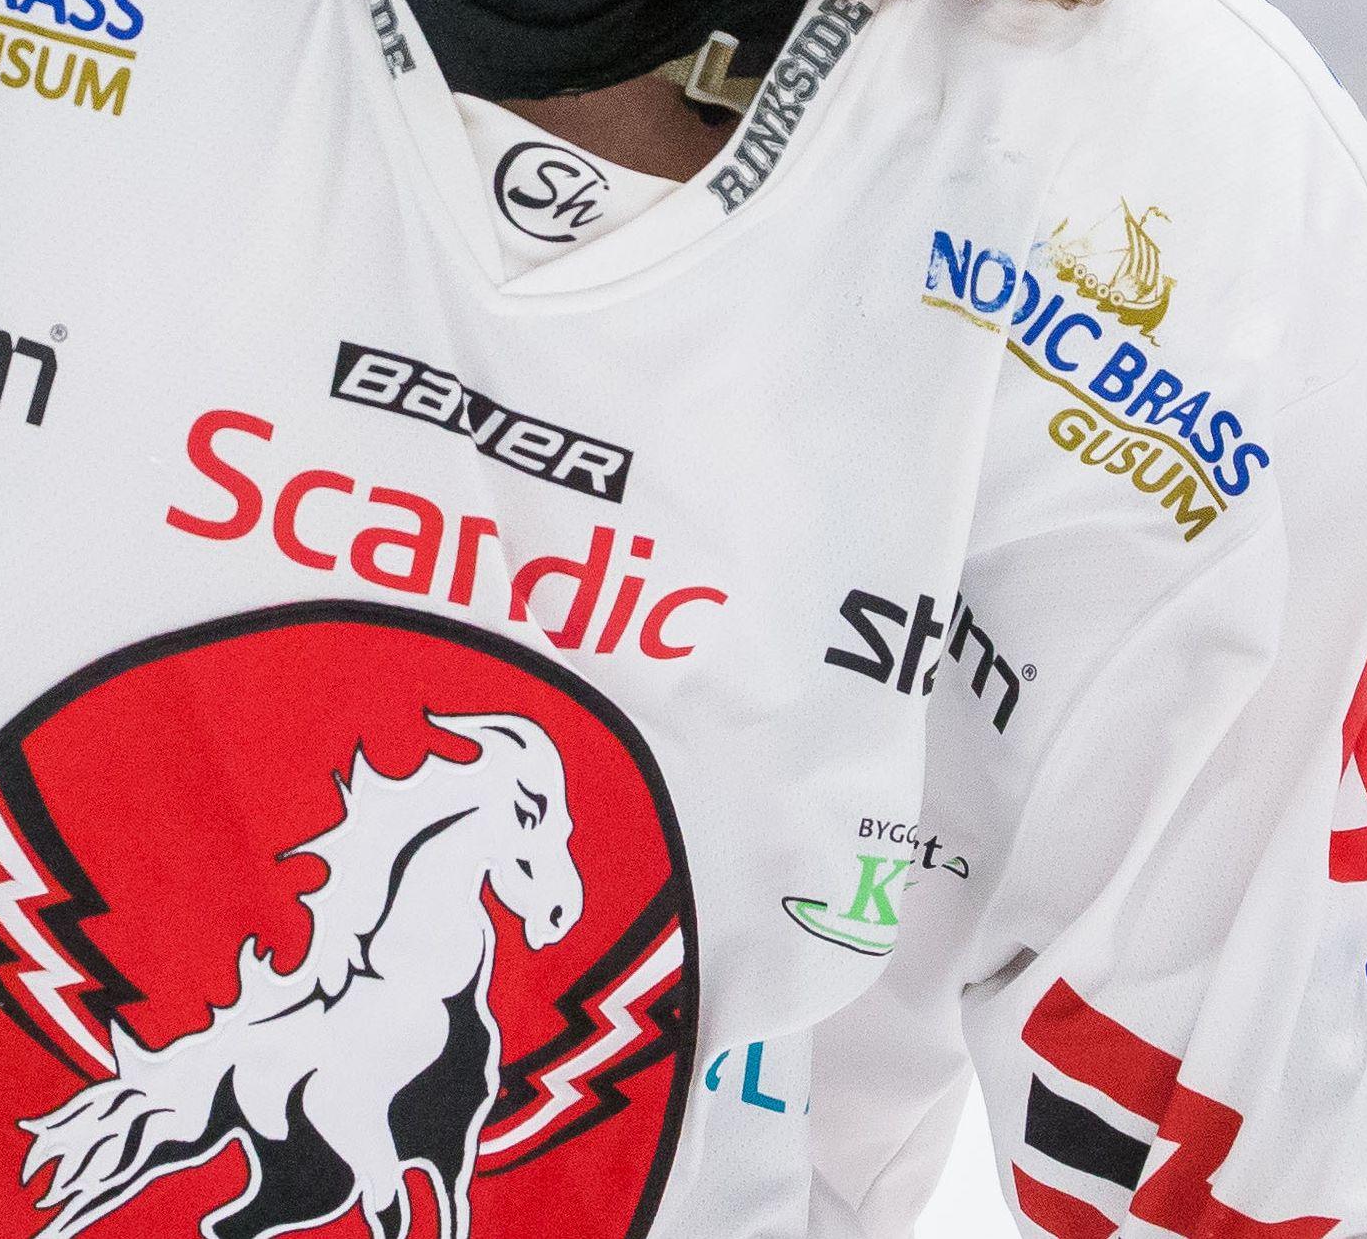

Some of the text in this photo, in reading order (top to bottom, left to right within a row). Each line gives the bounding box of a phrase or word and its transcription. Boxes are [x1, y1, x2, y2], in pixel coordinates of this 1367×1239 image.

[1048, 408, 1218, 543] GUSUM
[1089, 341, 1271, 497] BRASS
[166, 409, 729, 660] Scandic
